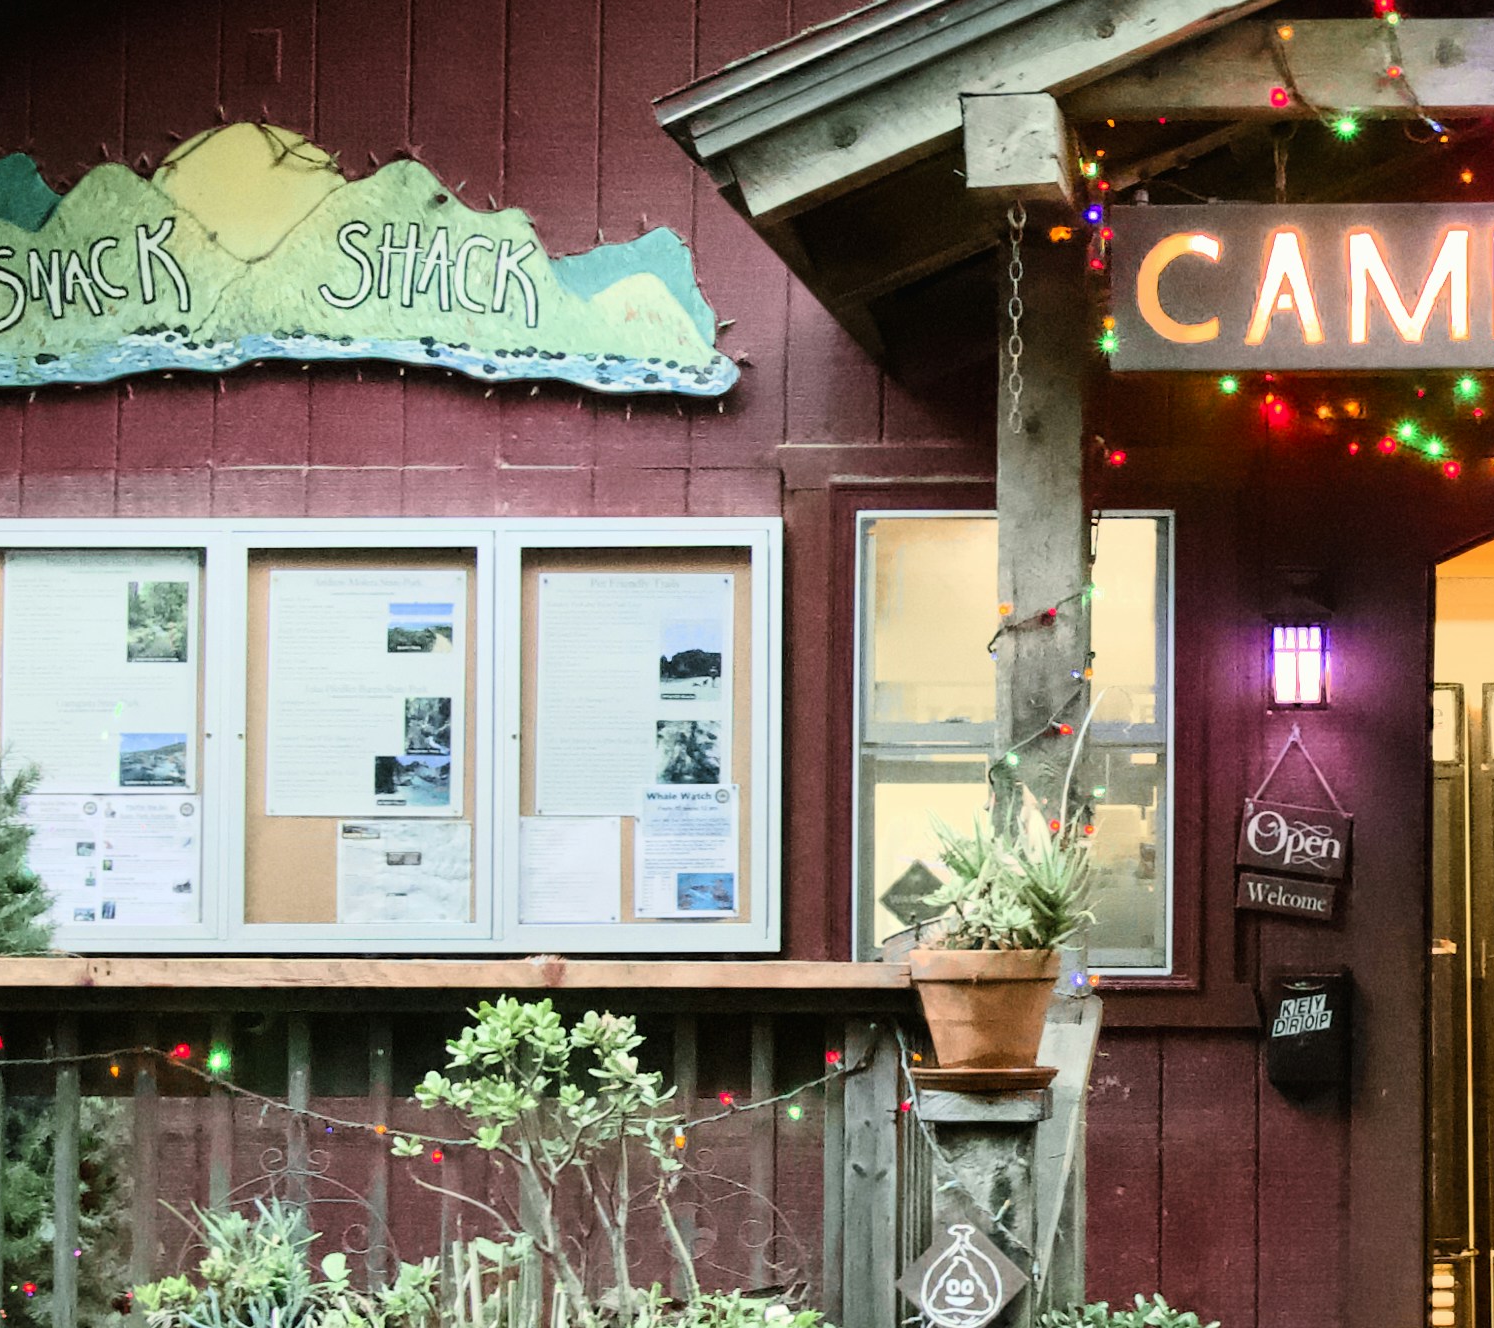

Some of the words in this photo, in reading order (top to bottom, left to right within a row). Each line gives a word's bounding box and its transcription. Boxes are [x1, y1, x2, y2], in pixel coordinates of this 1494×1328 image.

[318, 220, 539, 329] SHACK
[647, 792, 677, 800] Whale
[681, 792, 712, 800] Watch
[1246, 810, 1341, 869] Open
[1246, 881, 1327, 912] Welcome
[1281, 996, 1325, 1015] KEY
[1275, 1011, 1330, 1034] DROP
